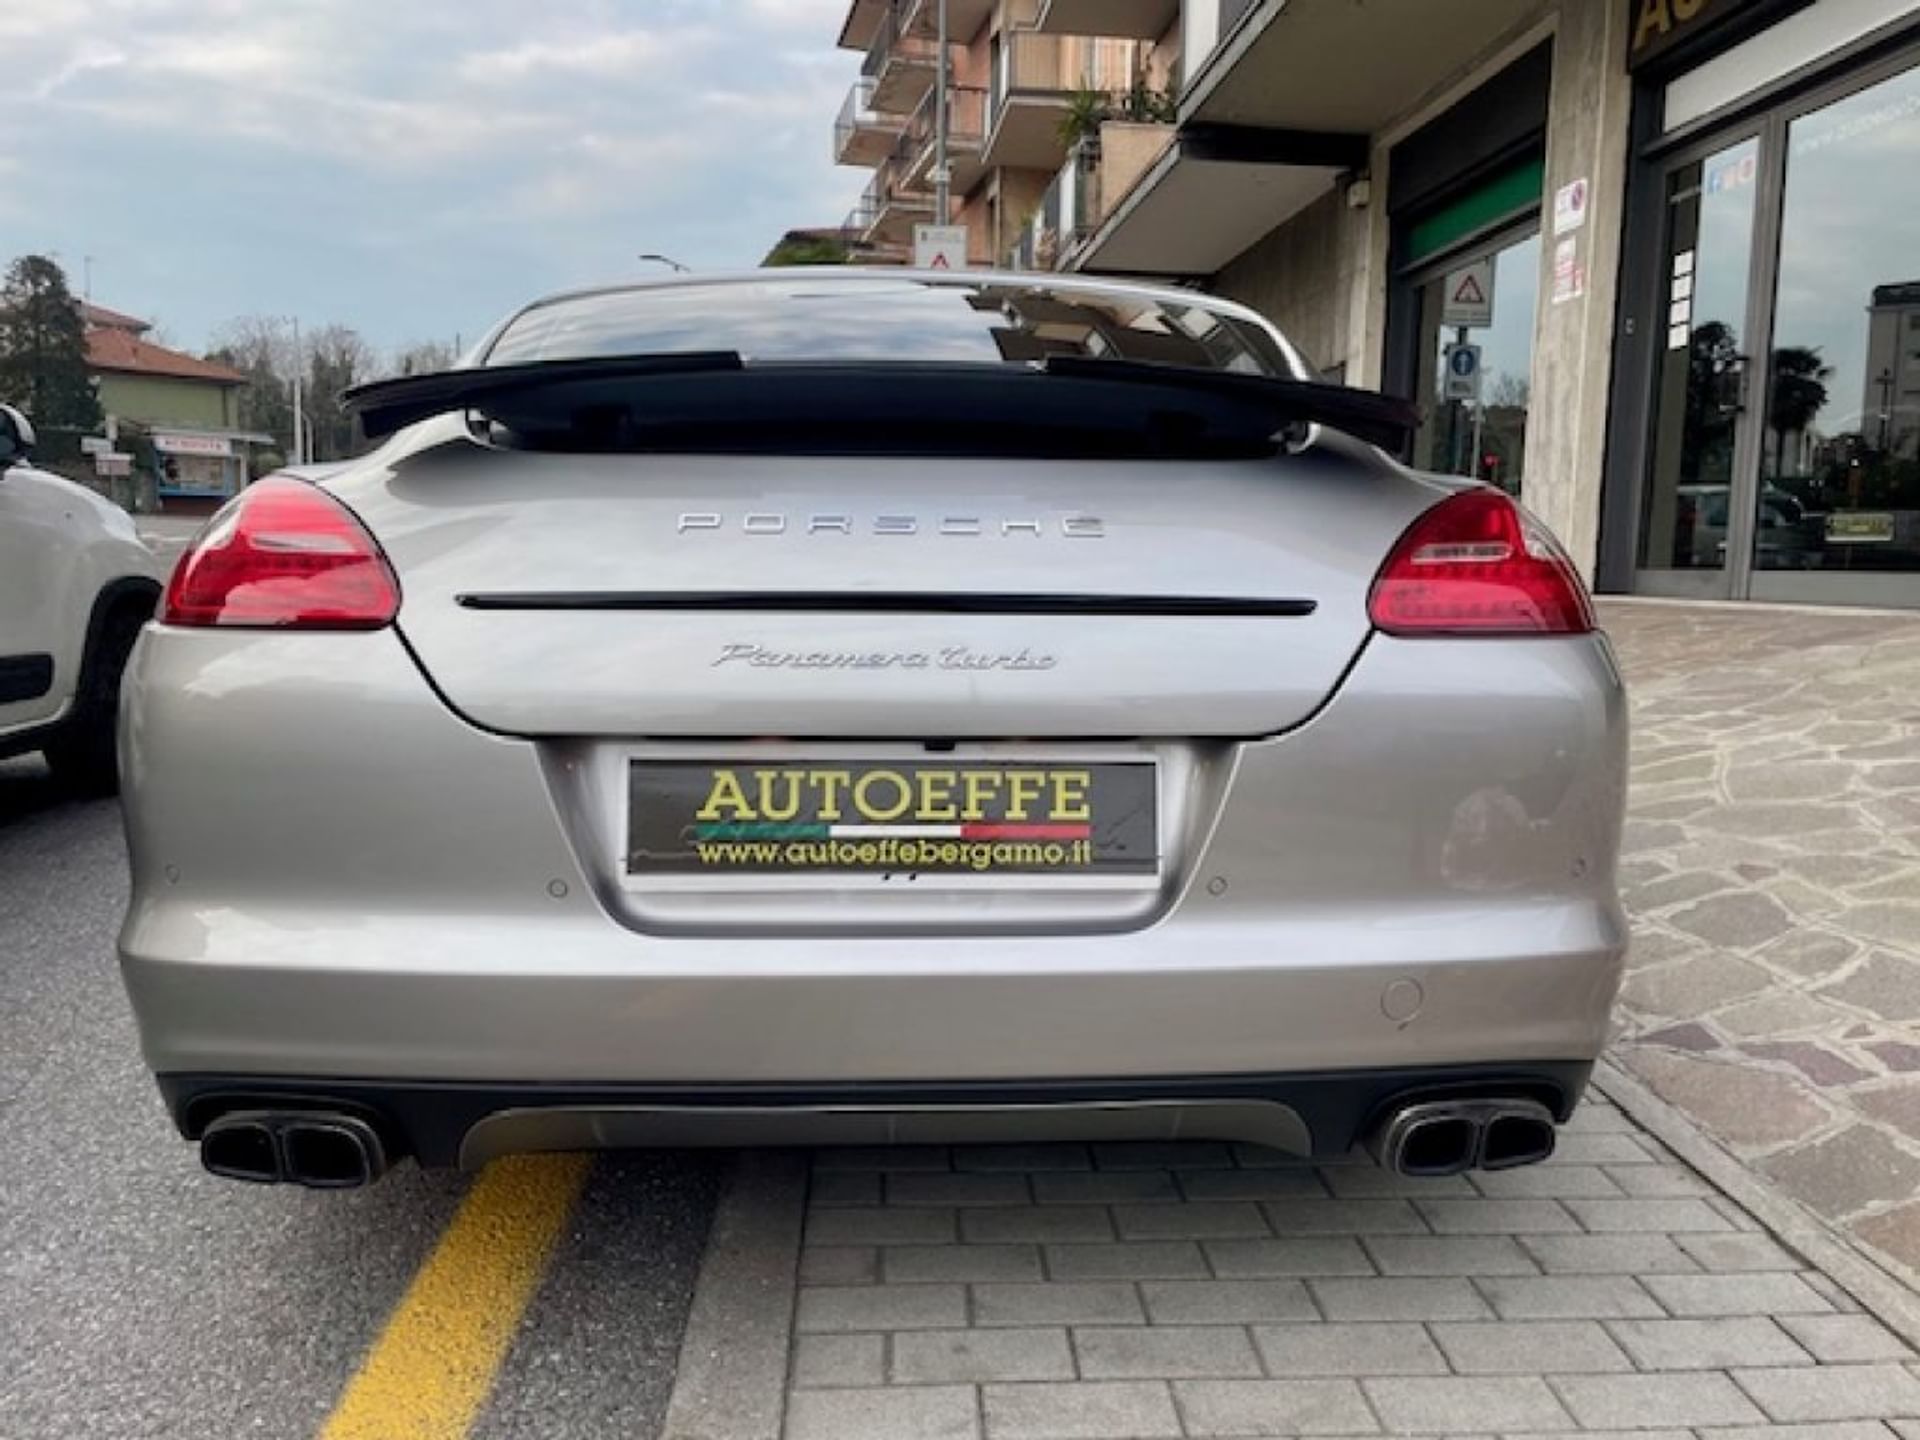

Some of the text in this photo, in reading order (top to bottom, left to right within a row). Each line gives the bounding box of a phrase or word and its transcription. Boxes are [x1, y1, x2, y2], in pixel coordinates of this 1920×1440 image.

[677, 512, 1105, 539] PORSCHE
[711, 643, 1058, 671] Panamera Turbo
[696, 770, 1092, 821] AUTOEFFE
[698, 837, 1092, 869] www.autoeffebergamo.it
